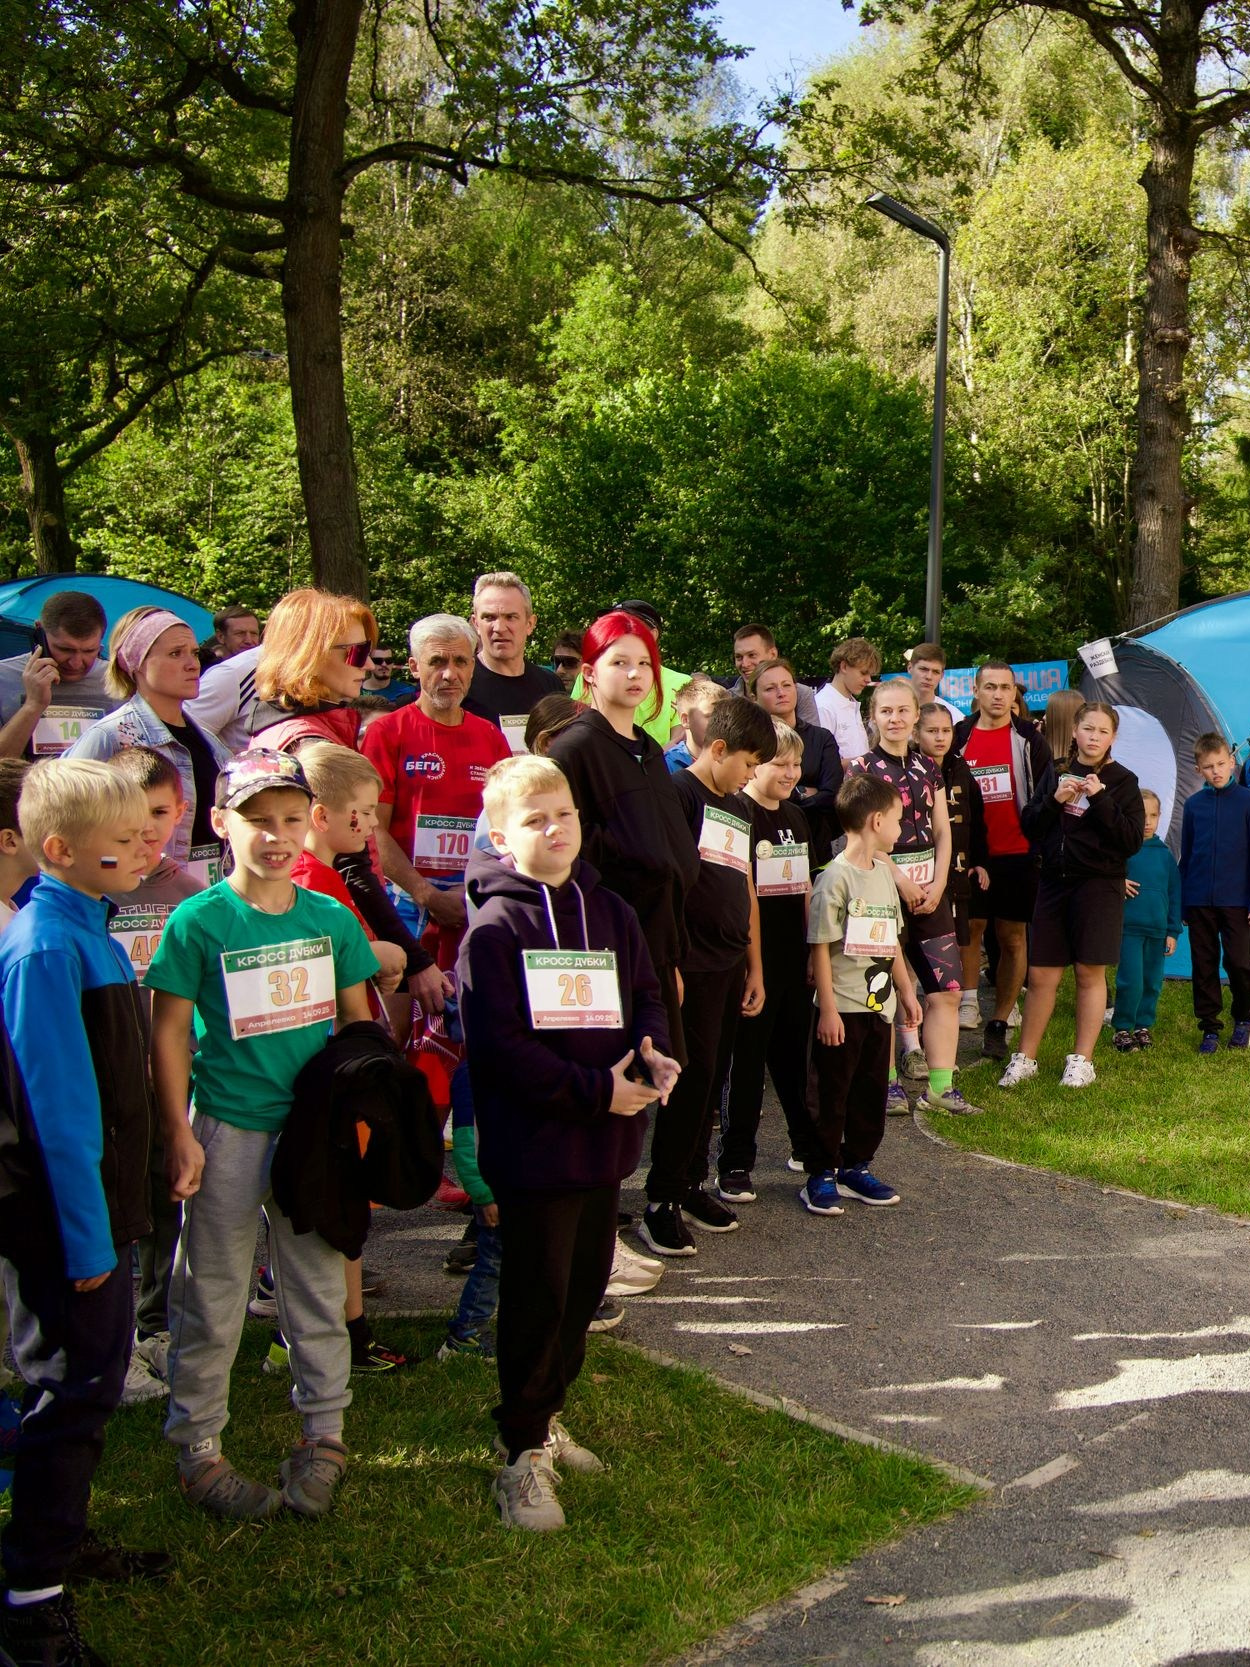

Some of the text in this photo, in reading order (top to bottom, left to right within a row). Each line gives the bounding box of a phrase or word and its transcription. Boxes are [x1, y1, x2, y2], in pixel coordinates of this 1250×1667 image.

[59, 721, 81, 740] 14
[405, 761, 440, 771] БЕГИ
[425, 819, 456, 827] КРОСС
[711, 812, 732, 824] КРОСС
[436, 833, 469, 855] 170
[724, 829, 735, 852] 2
[782, 860, 793, 881] 4
[237, 943, 324, 968] КРОСС ДУБКИ
[535, 957, 607, 967] КРОСС ДУБКИ
[268, 967, 311, 1006] 32
[558, 974, 593, 1006] 26
[248, 1016, 296, 1029] Апрелевка
